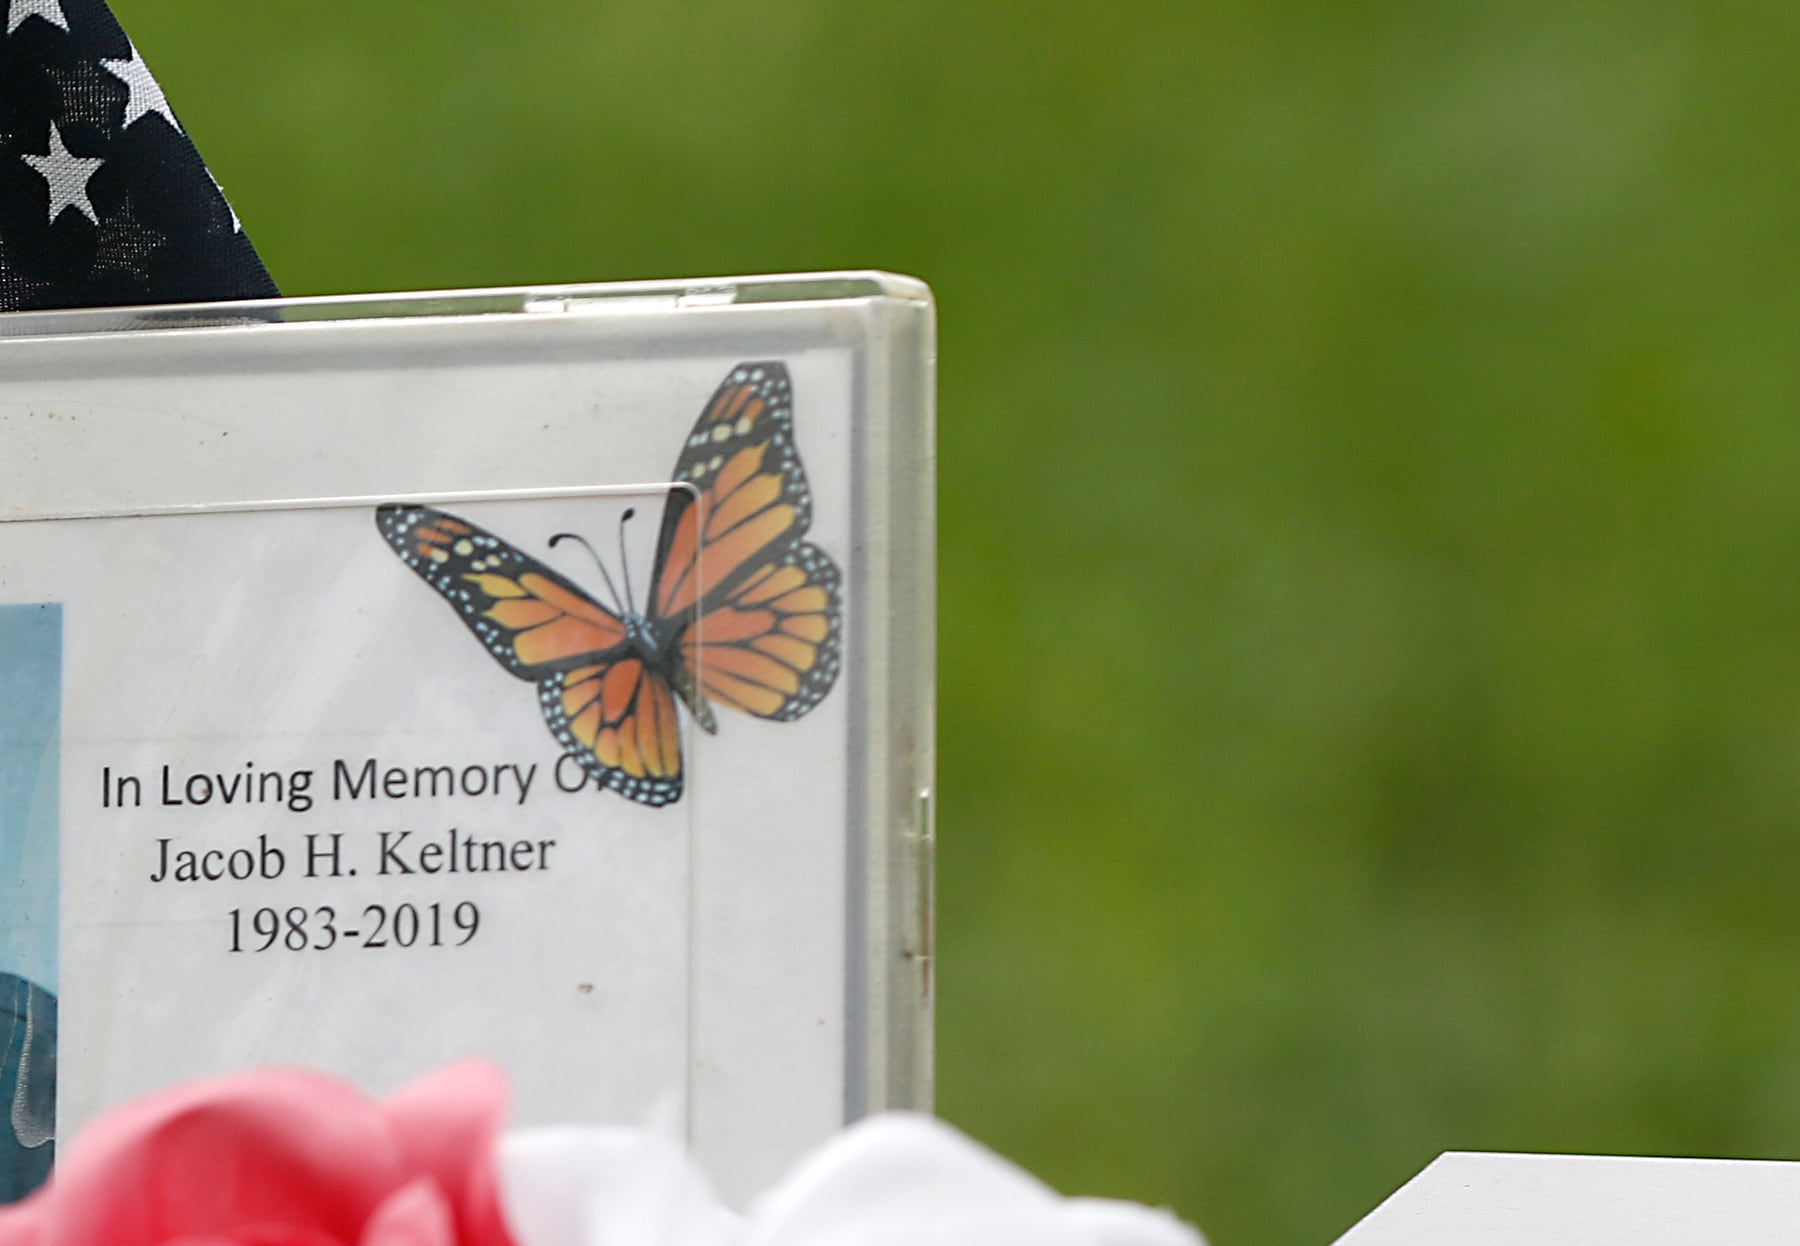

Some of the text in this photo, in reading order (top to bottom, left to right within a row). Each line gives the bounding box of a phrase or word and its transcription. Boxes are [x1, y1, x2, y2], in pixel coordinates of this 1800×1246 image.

[102, 751, 606, 813] In Loving Memory O
[149, 828, 557, 884] Jacob H. Keltner
[228, 900, 481, 954] 1983-2019
